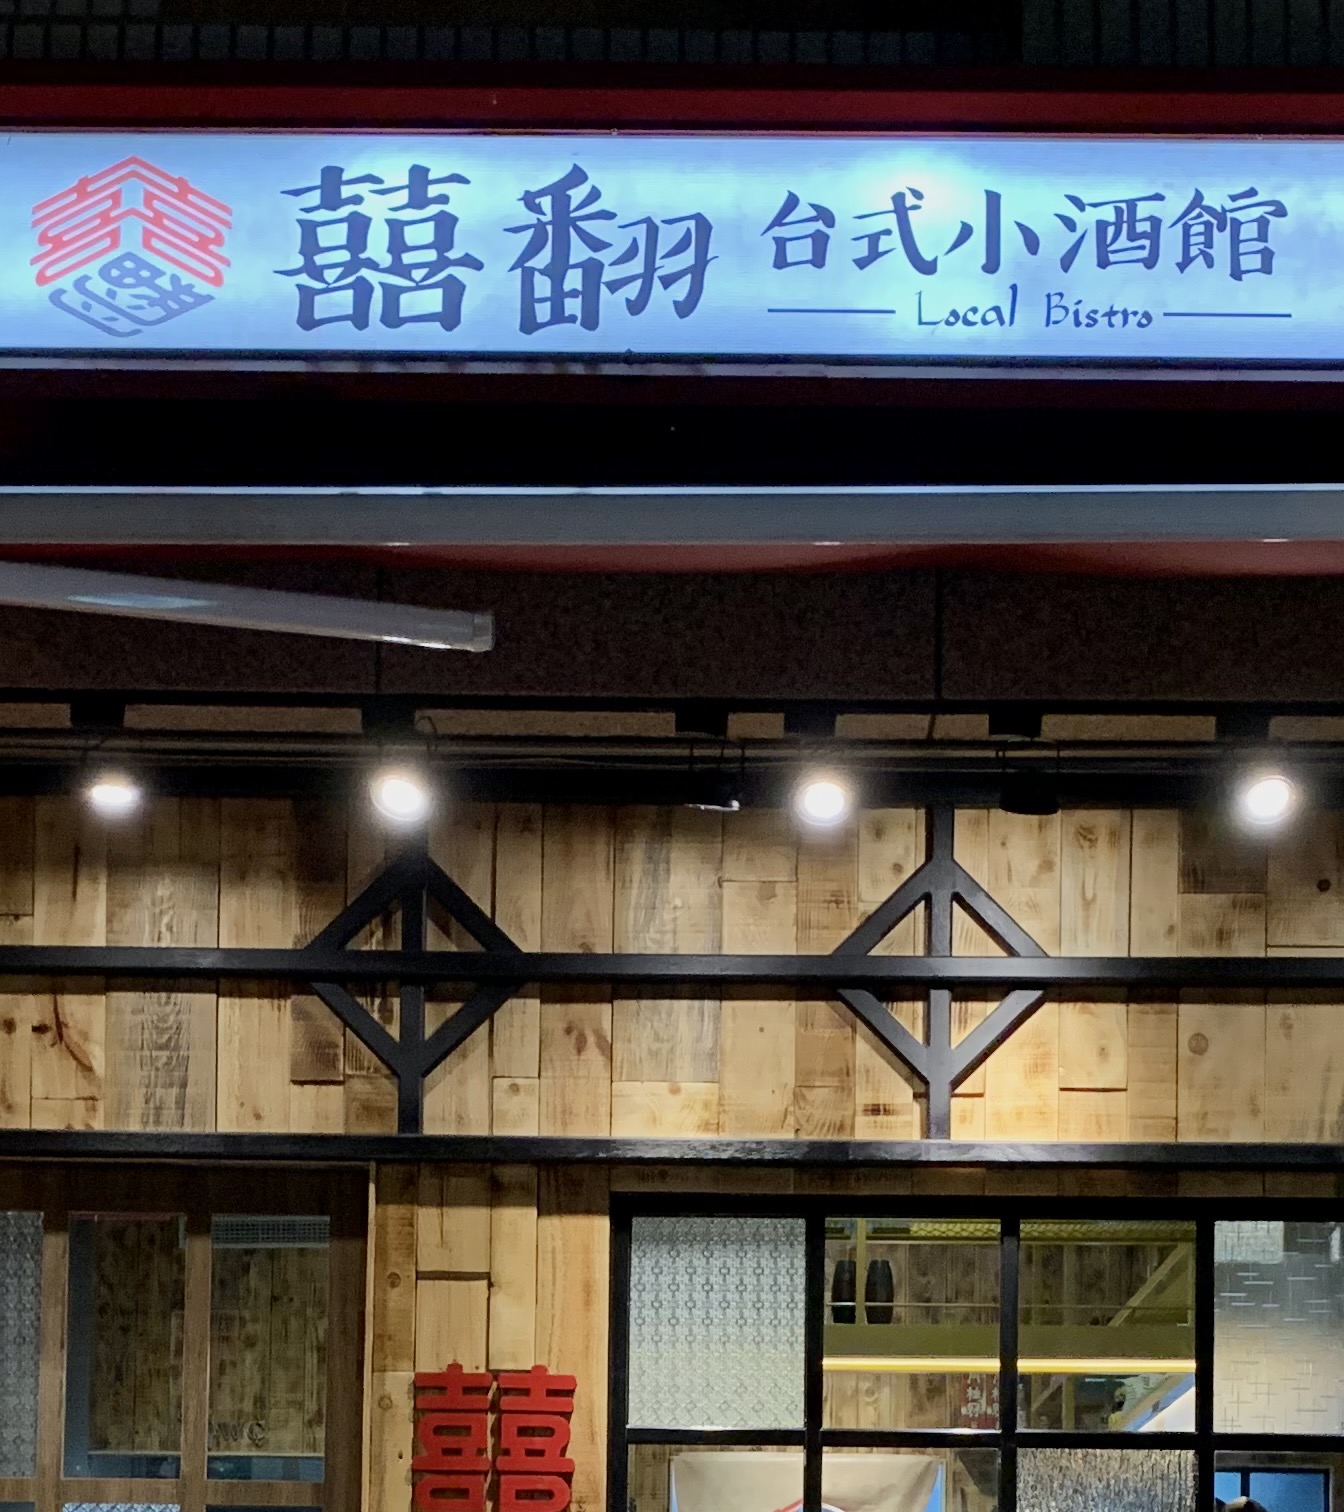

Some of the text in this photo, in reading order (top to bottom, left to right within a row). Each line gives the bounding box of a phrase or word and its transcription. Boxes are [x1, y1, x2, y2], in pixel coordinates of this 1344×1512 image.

[761, 187, 1289, 282] 台式小酒館
[914, 283, 1154, 331] Local Bistro
